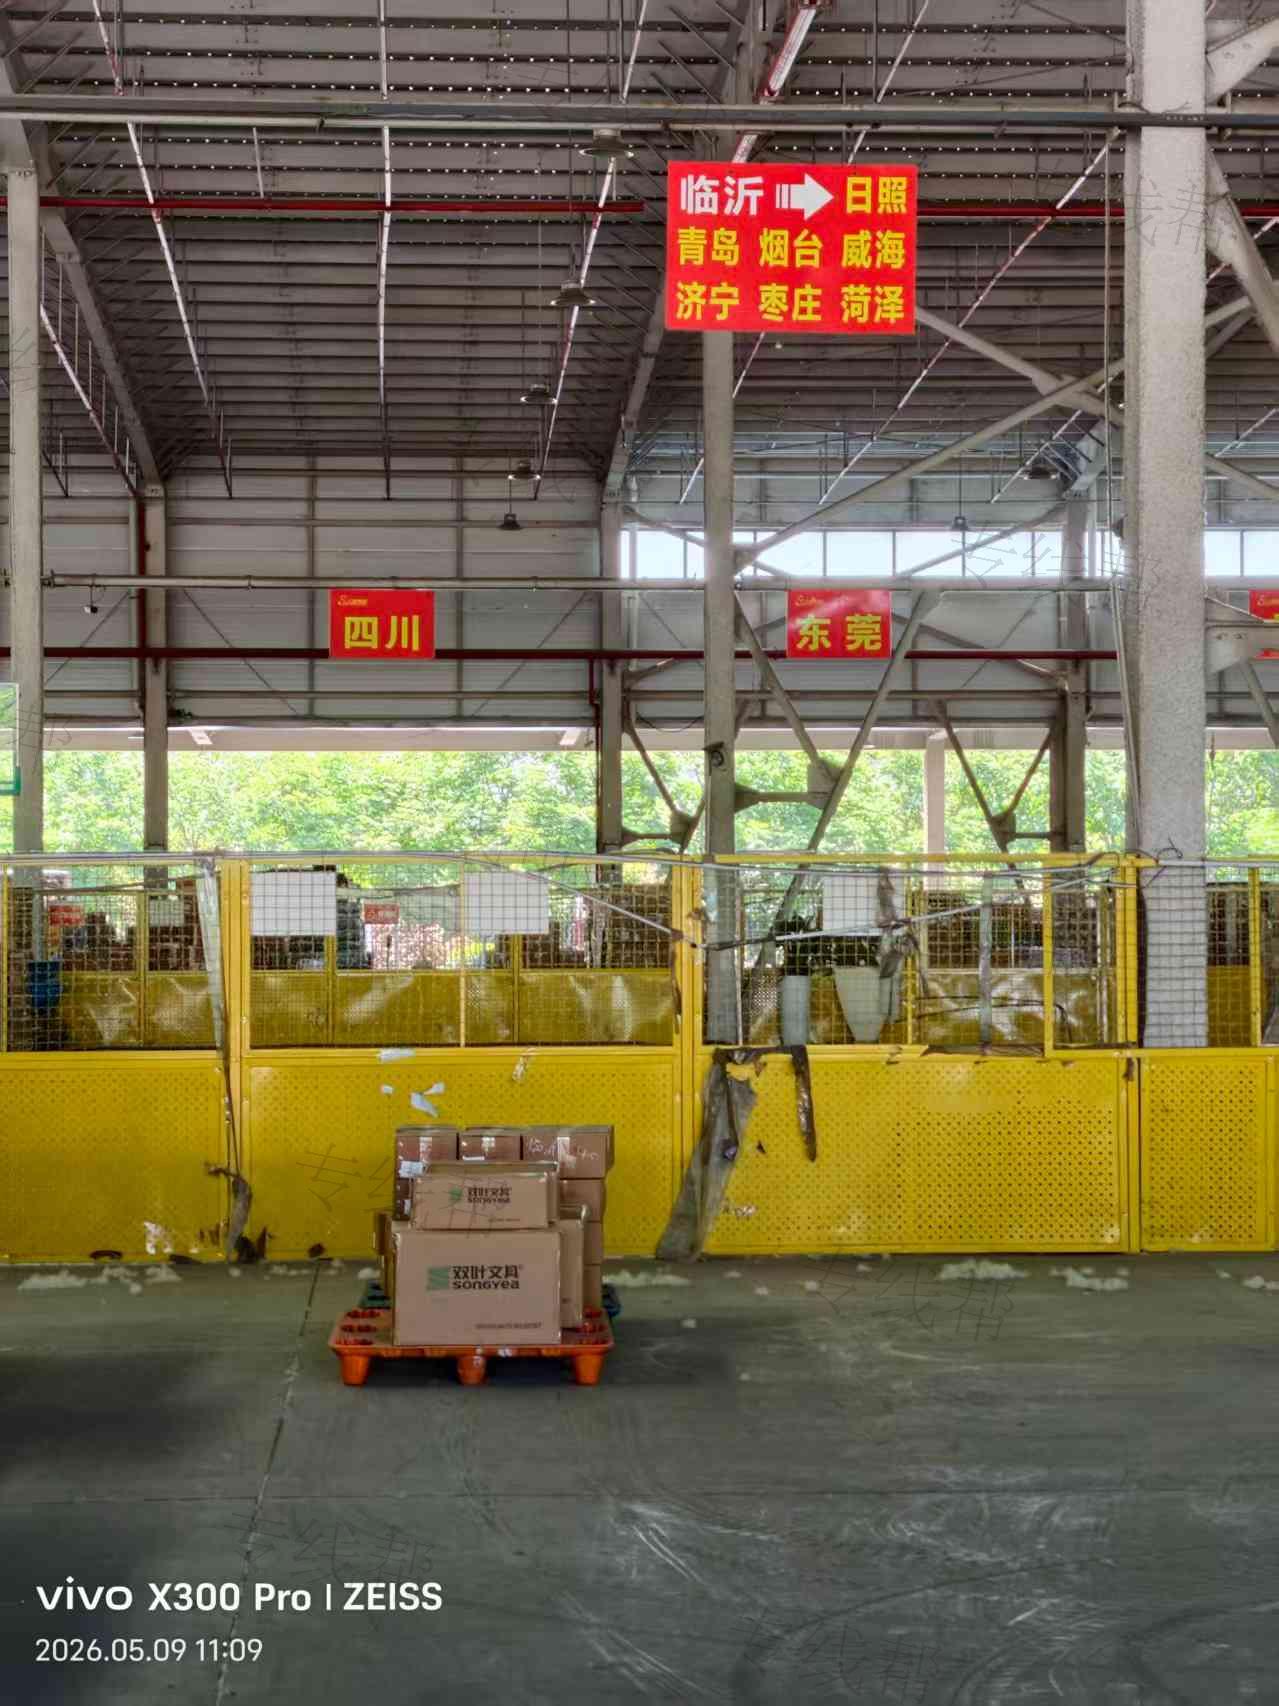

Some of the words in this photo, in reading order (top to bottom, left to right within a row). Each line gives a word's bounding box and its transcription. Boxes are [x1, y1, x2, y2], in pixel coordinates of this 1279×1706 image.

[680, 174, 764, 216] 临沂
[846, 176, 908, 215] 日照
[677, 225, 740, 267] 青岛
[759, 227, 823, 269] 烟台
[841, 229, 906, 270] 威海
[676, 281, 740, 321] 济宁
[758, 282, 823, 323] 枣庄
[840, 283, 905, 324] 菏泽
[344, 614, 420, 651] 四川
[794, 612, 882, 652] 东莞
[452, 1264, 519, 1280] 双叶文具
